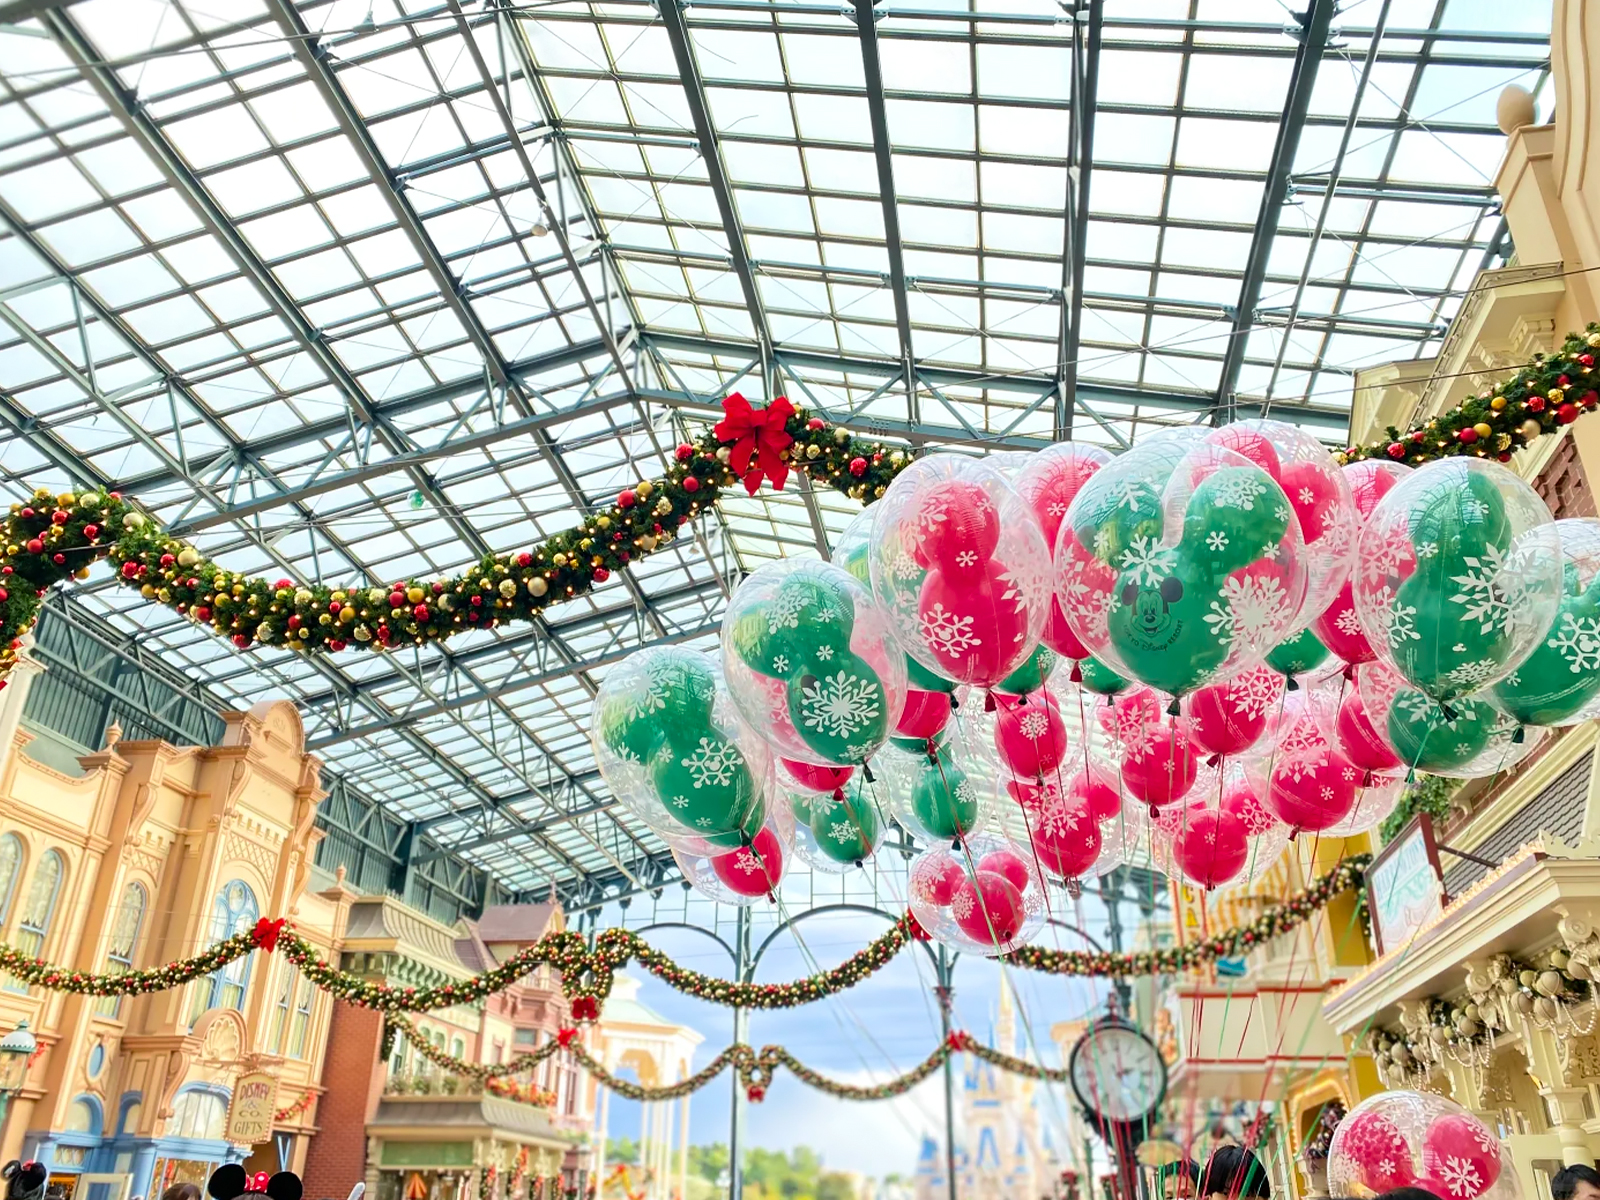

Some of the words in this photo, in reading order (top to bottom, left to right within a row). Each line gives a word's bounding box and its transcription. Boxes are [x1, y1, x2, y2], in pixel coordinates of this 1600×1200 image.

[1167, 618, 1183, 645] RESORT
[239, 1082, 271, 1101] DISNEY
[233, 1120, 263, 1136] GIFTS
